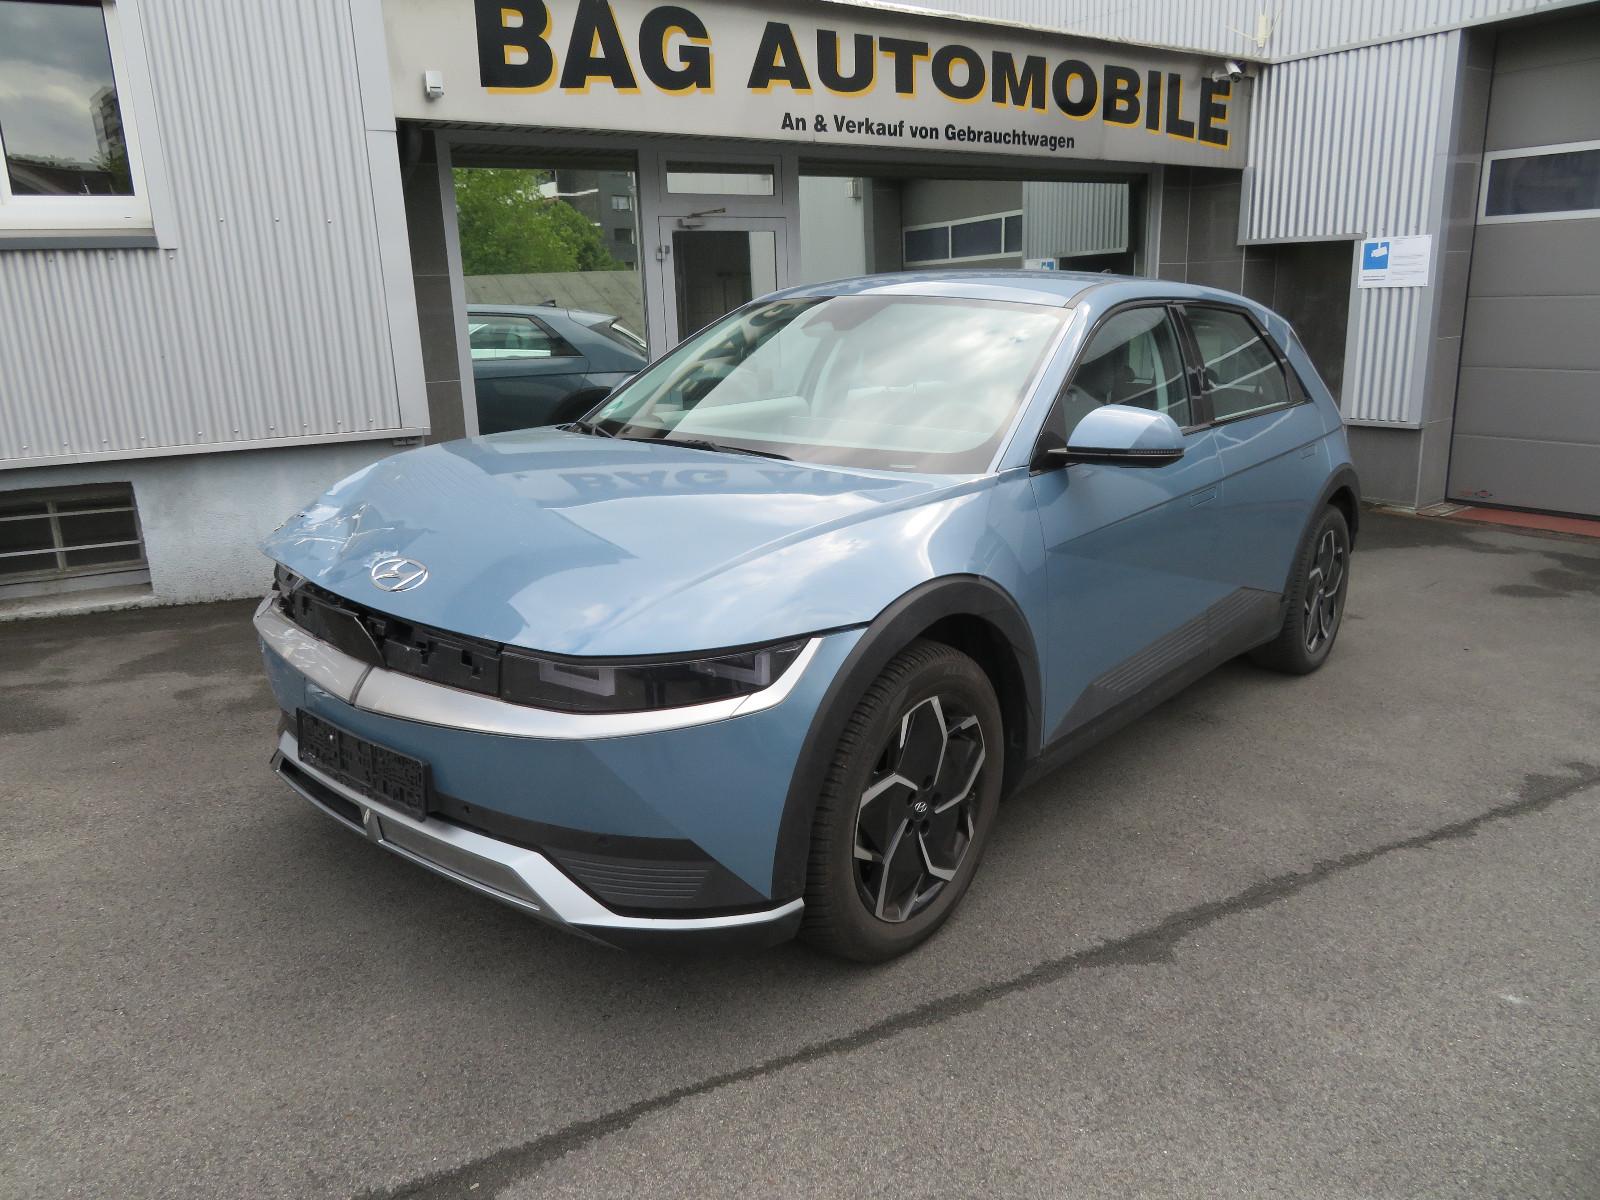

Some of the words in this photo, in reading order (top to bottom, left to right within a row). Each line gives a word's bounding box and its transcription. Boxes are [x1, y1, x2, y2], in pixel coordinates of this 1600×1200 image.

[474, 0, 715, 95] BAG
[747, 21, 1230, 150] AUTOMOBILE
[781, 112, 807, 132] An
[813, 114, 828, 133] &
[834, 115, 905, 138] Verkauf
[909, 125, 939, 140] von
[944, 123, 1075, 151] Gebrauchtwagen
